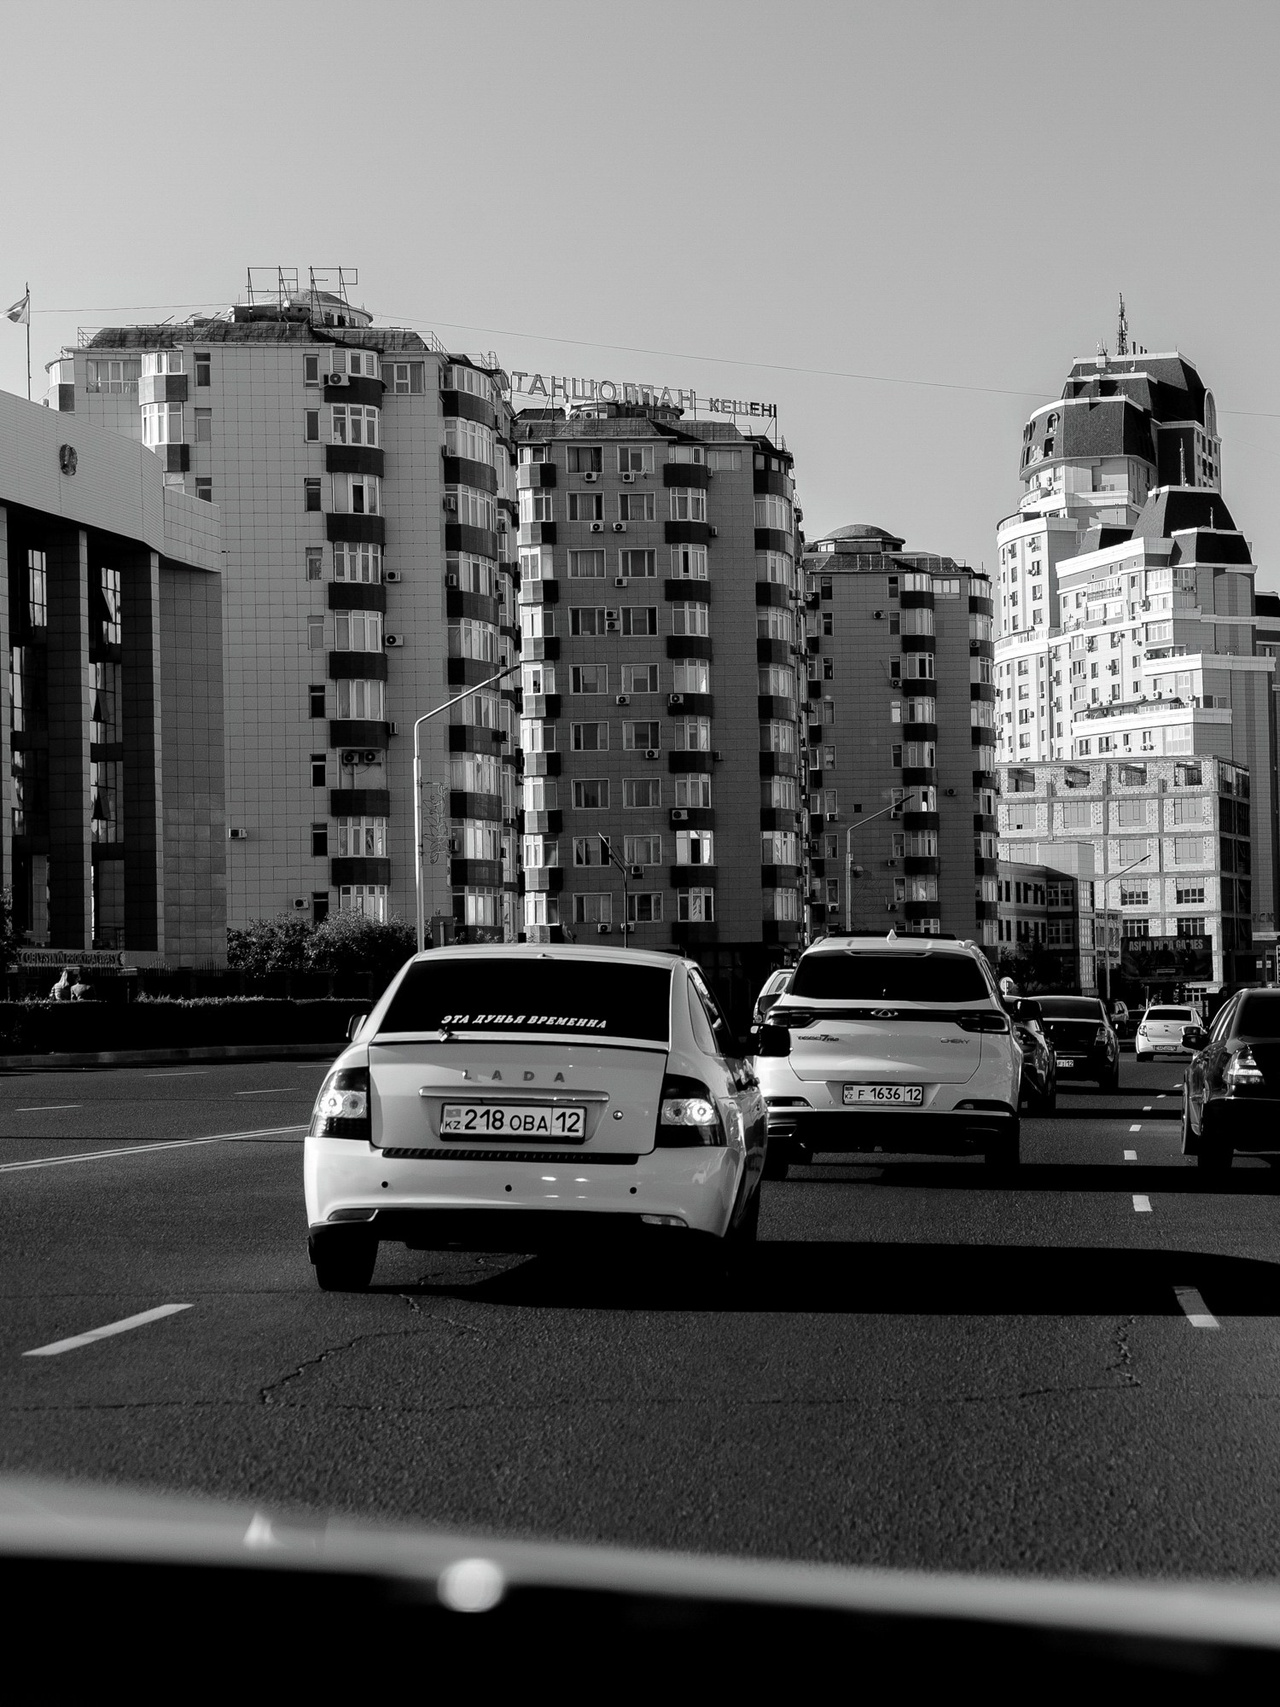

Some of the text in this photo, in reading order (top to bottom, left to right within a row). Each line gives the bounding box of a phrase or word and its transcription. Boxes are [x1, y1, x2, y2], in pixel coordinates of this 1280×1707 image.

[441, 1014, 607, 1028] ЭТА ДУНЬЯ ВРЕМЕННА
[940, 1037, 970, 1045] CHERY
[463, 1069, 565, 1083] LADA
[857, 1090, 866, 1099] F
[870, 1087, 901, 1100] 1636
[906, 1088, 921, 1101] 12
[444, 1108, 581, 1133] KZ 218 OBA 12
